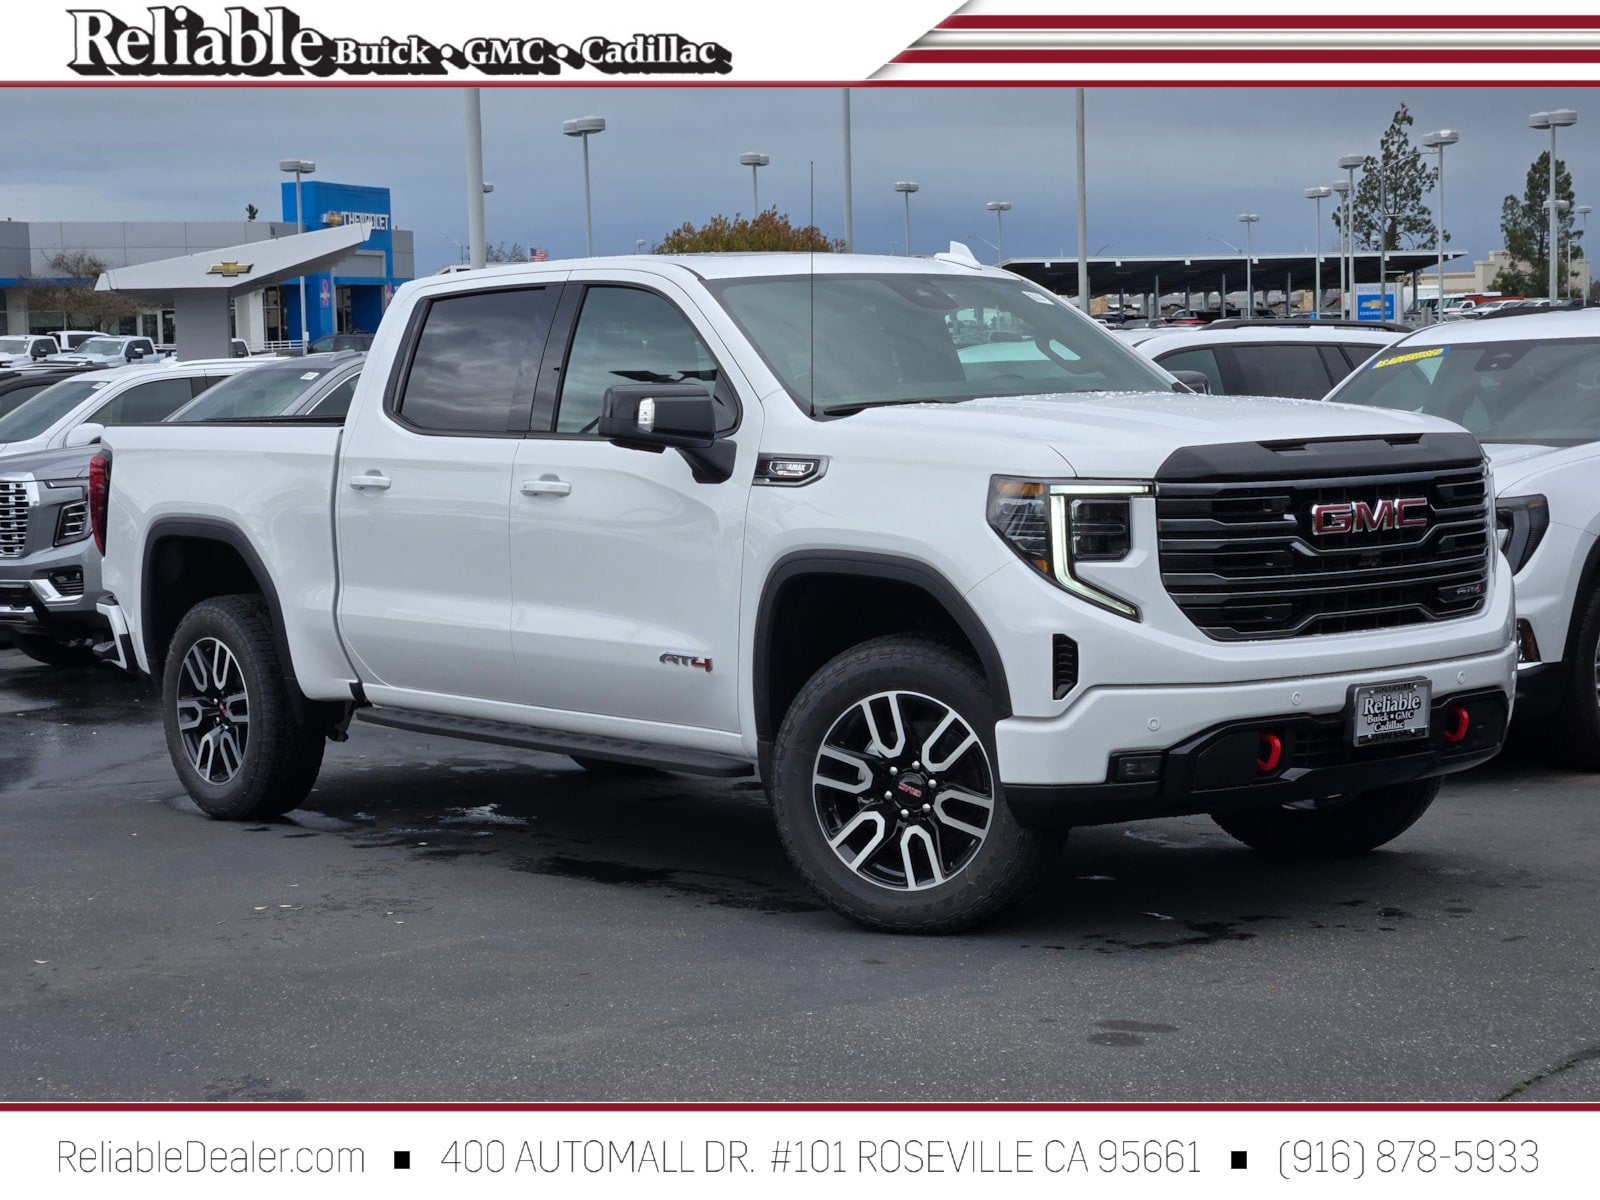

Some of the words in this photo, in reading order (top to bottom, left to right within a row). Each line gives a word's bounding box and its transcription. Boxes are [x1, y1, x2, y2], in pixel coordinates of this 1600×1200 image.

[1311, 497, 1428, 536] GMC
[659, 653, 713, 673] AT4
[1363, 692, 1421, 716] Reliable
[1367, 712, 1390, 724] Buick
[1395, 710, 1415, 720] GMC
[1374, 721, 1405, 733] Cadillac
